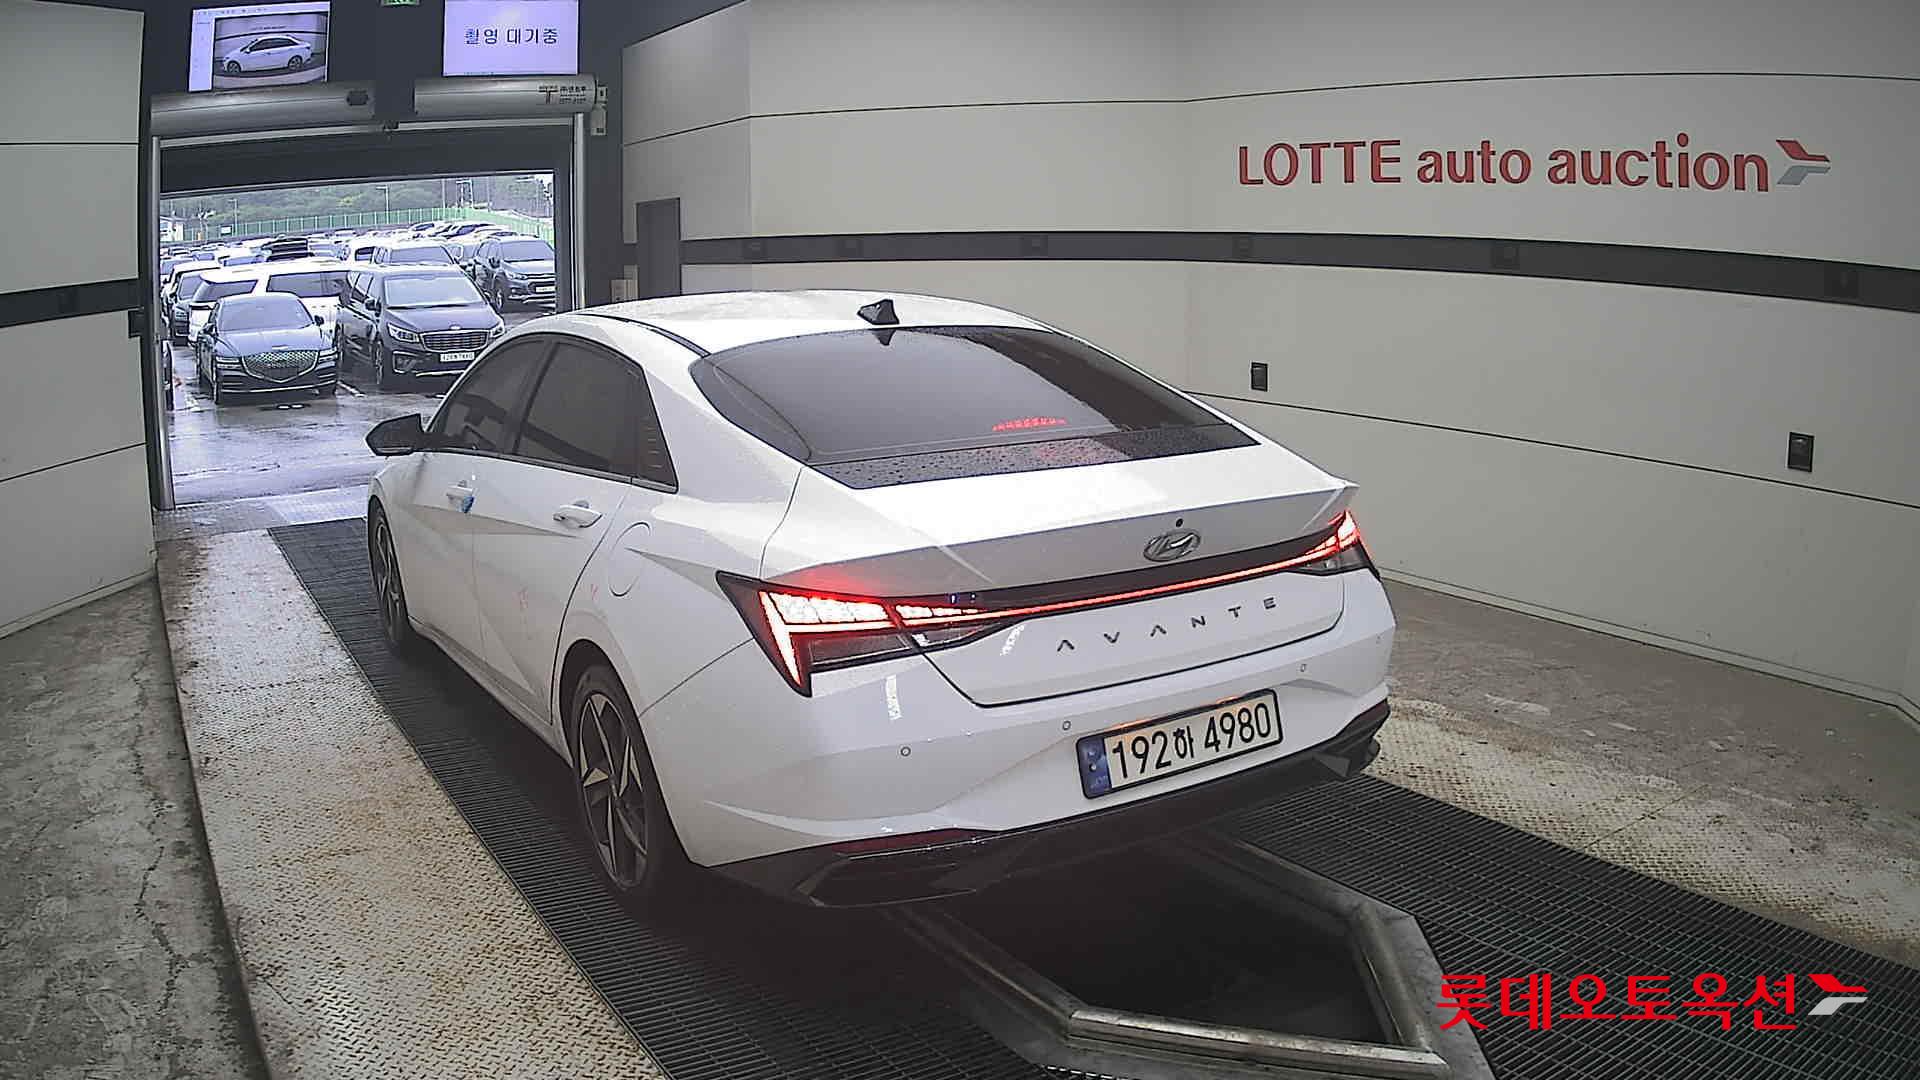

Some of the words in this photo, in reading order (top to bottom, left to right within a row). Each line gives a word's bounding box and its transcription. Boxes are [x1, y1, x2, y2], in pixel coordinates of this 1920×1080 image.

[506, 28, 558, 45] 대기중
[1238, 139, 1401, 185] LOTTE
[1416, 140, 1532, 184] auto
[1548, 132, 1769, 192] auction
[1056, 596, 1277, 652] AVANTE
[1111, 725, 1194, 779] 192하
[1204, 702, 1271, 752] 4980
